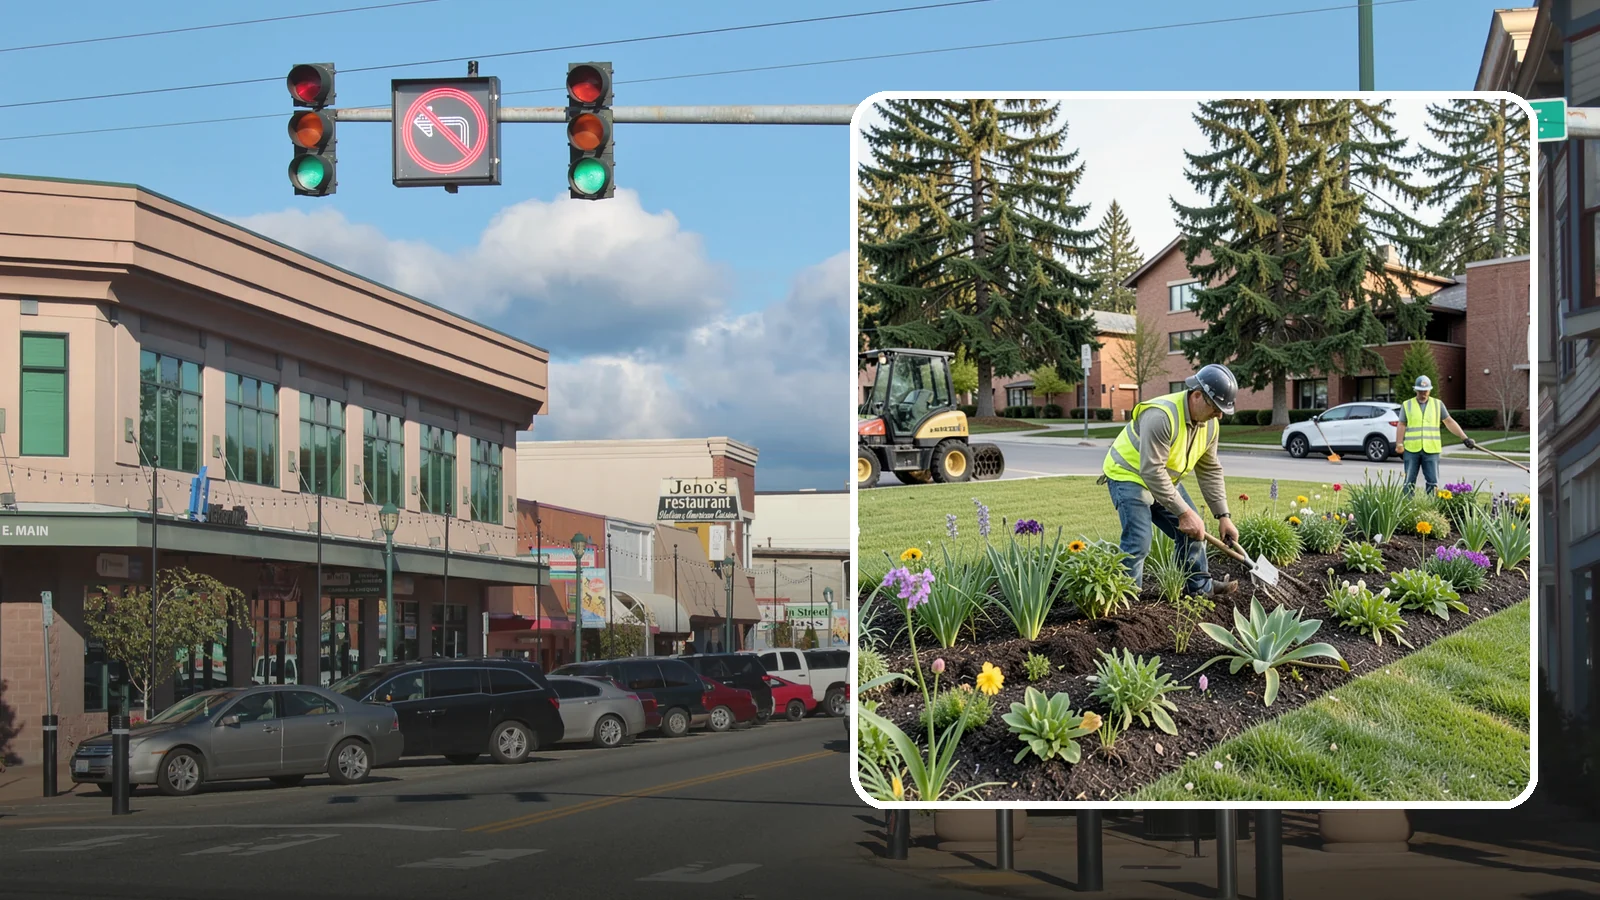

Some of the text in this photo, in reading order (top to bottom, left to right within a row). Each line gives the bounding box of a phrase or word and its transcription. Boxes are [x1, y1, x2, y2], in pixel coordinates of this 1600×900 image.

[669, 480, 727, 494] Jeno's
[665, 496, 731, 509] restaurant
[686, 509, 714, 519] American
[715, 509, 737, 519] Cuisine
[2, 525, 49, 536] E. MAIN
[797, 608, 828, 616] Street
